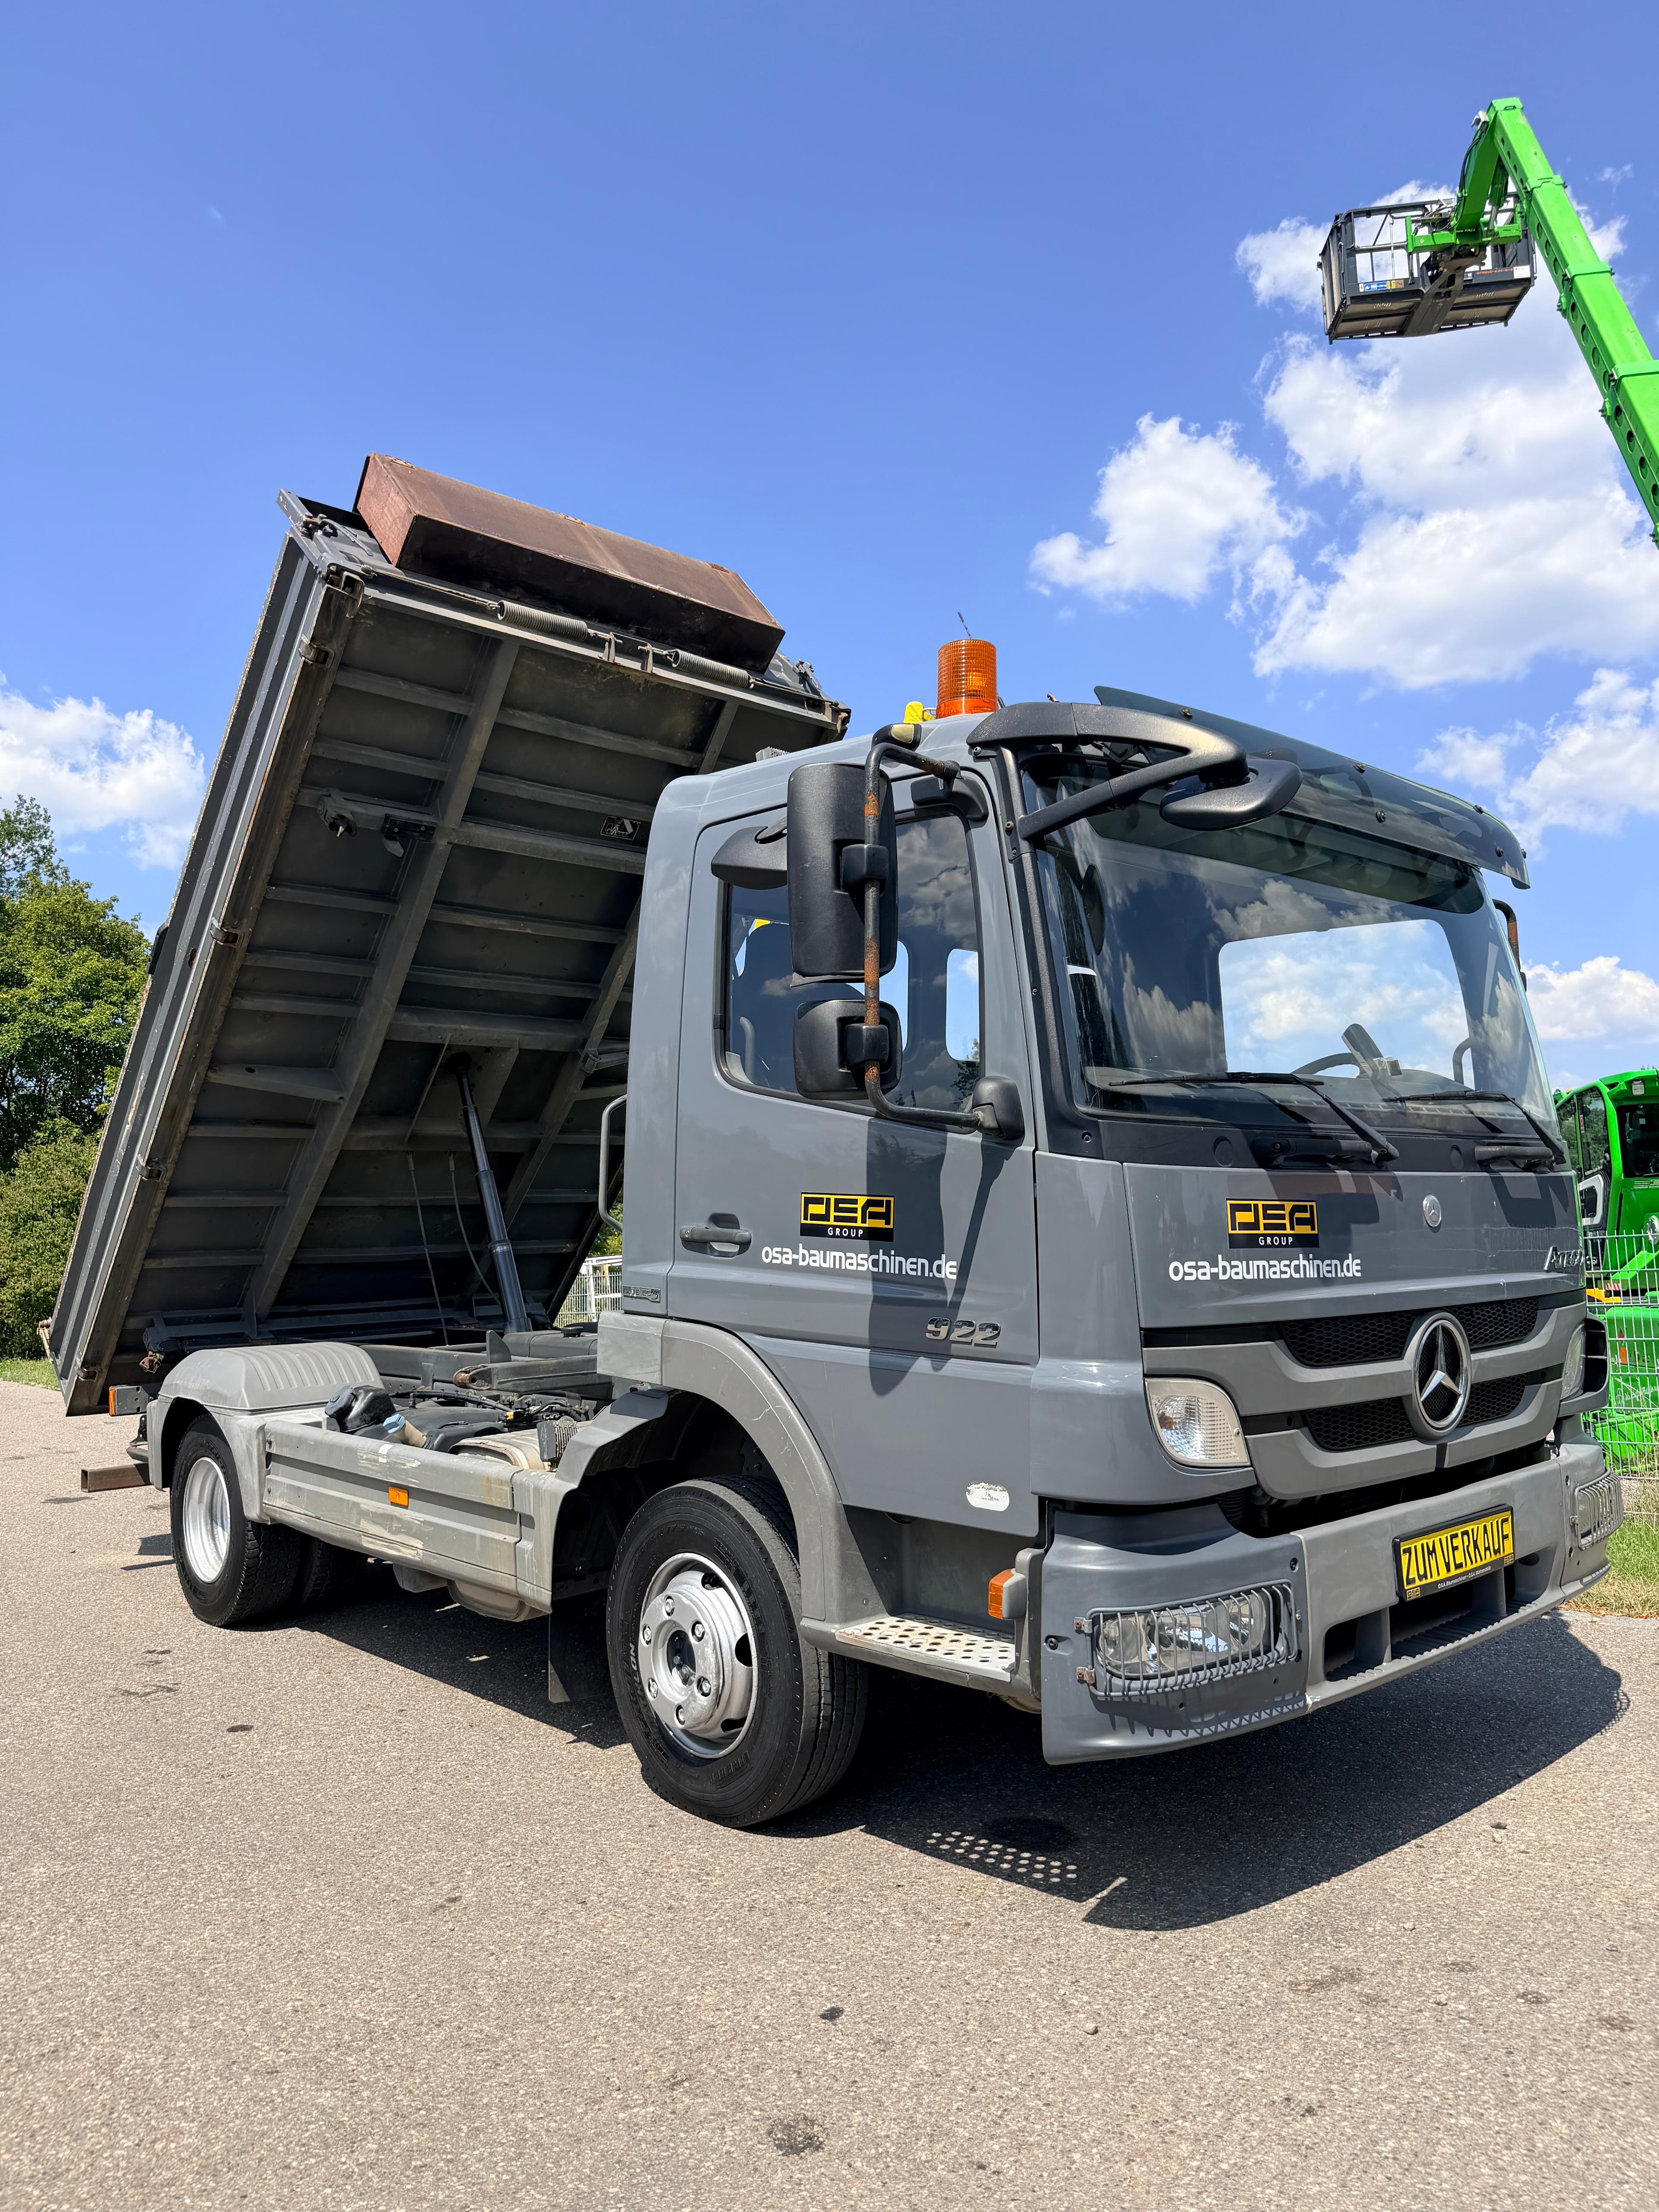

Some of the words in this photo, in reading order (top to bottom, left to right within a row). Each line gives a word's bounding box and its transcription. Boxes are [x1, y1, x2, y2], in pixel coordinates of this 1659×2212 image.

[827, 1227, 864, 1237] GROUP
[1259, 1236, 1293, 1246] GROUP
[762, 1243, 957, 1280] osa-baumaschinen.de
[1169, 1253, 1361, 1281] osa-baumaschinen.de
[925, 1316, 1001, 1348] 922
[1402, 1539, 1440, 1586] ZUM
[1439, 1517, 1509, 1573] VERKAUF
